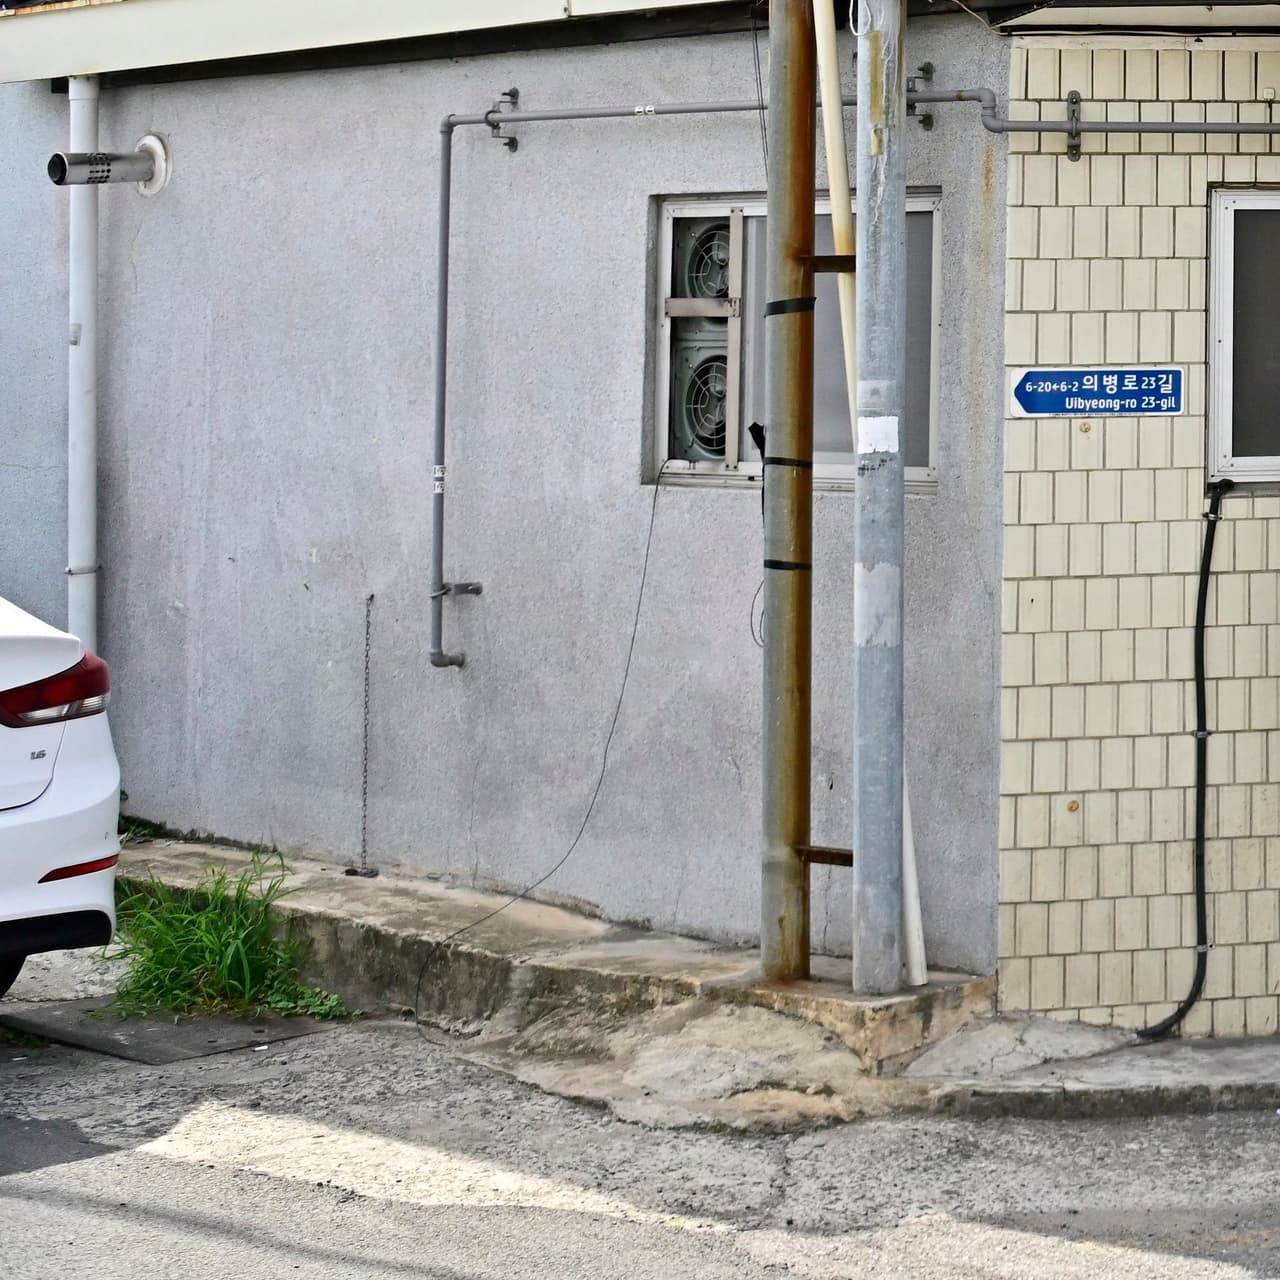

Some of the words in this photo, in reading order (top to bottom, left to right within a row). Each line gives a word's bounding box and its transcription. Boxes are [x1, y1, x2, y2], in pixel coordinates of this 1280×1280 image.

[1025, 381, 1053, 393] 6-20
[1060, 381, 1079, 392] 6-2
[1065, 396, 1137, 411] Uibyeong-ro
[1141, 396, 1176, 410] 23-gil
